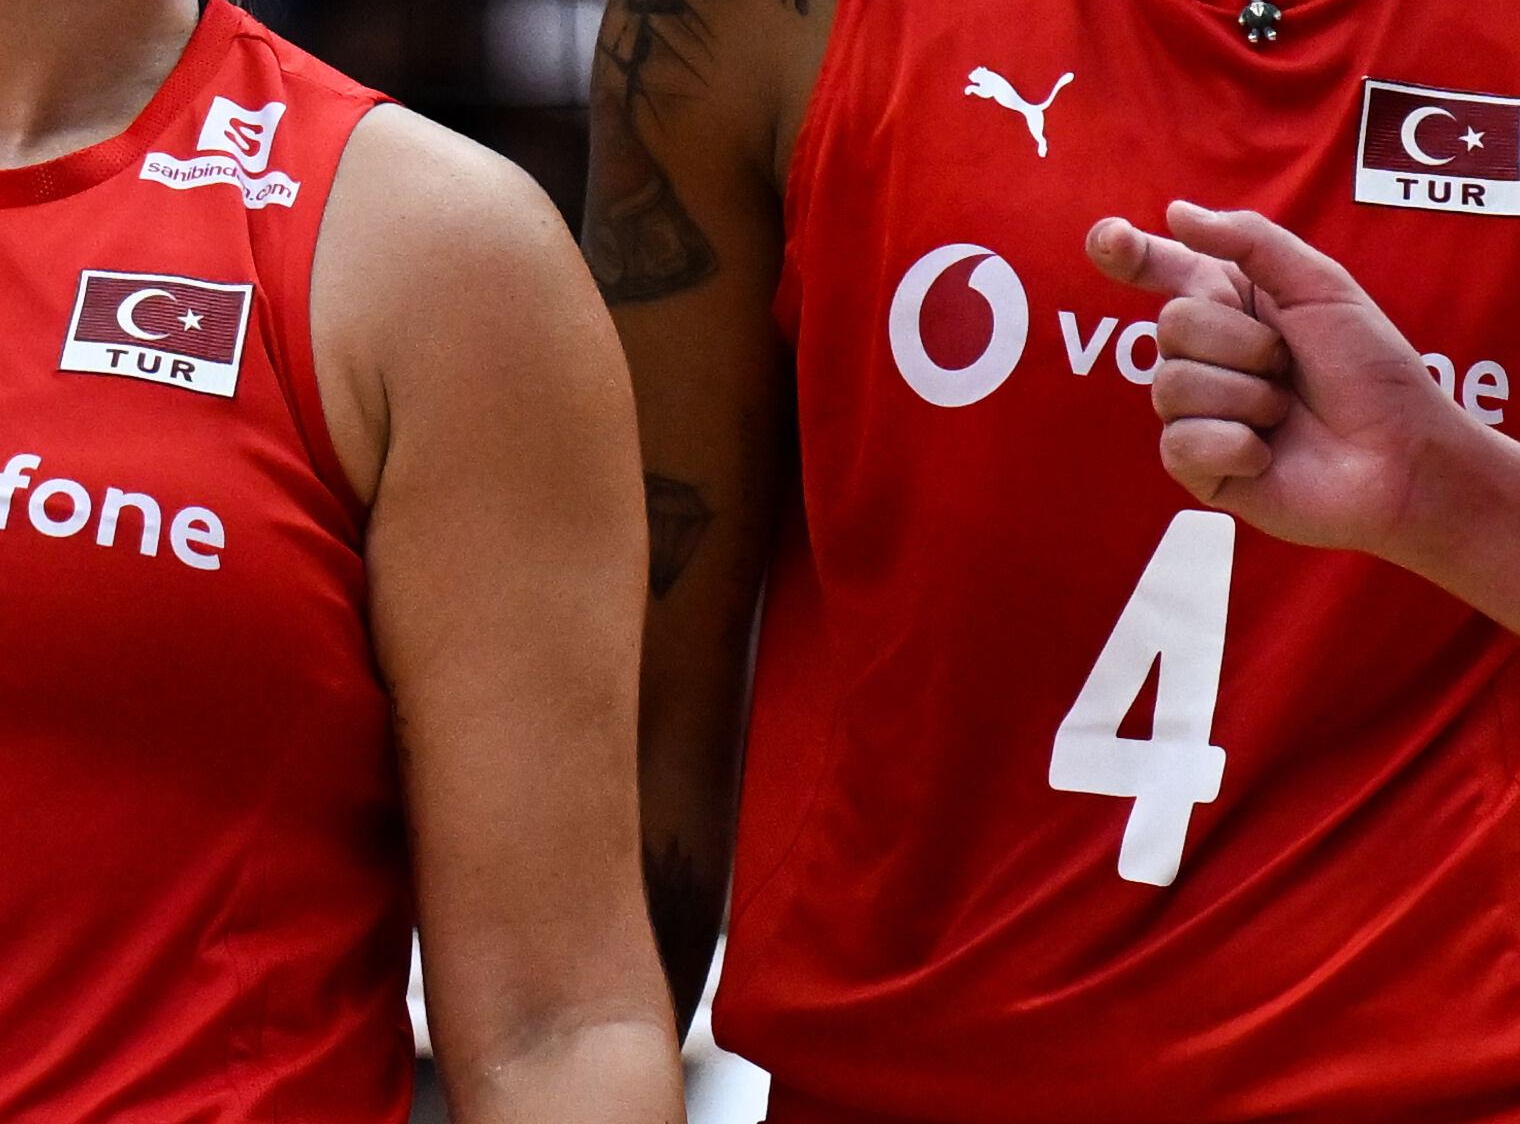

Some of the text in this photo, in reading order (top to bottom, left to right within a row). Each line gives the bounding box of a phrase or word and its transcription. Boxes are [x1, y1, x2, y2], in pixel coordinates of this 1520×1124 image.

[1395, 177, 1487, 208] TUR
[105, 347, 197, 383] TUR
[1048, 509, 1237, 888] 4
